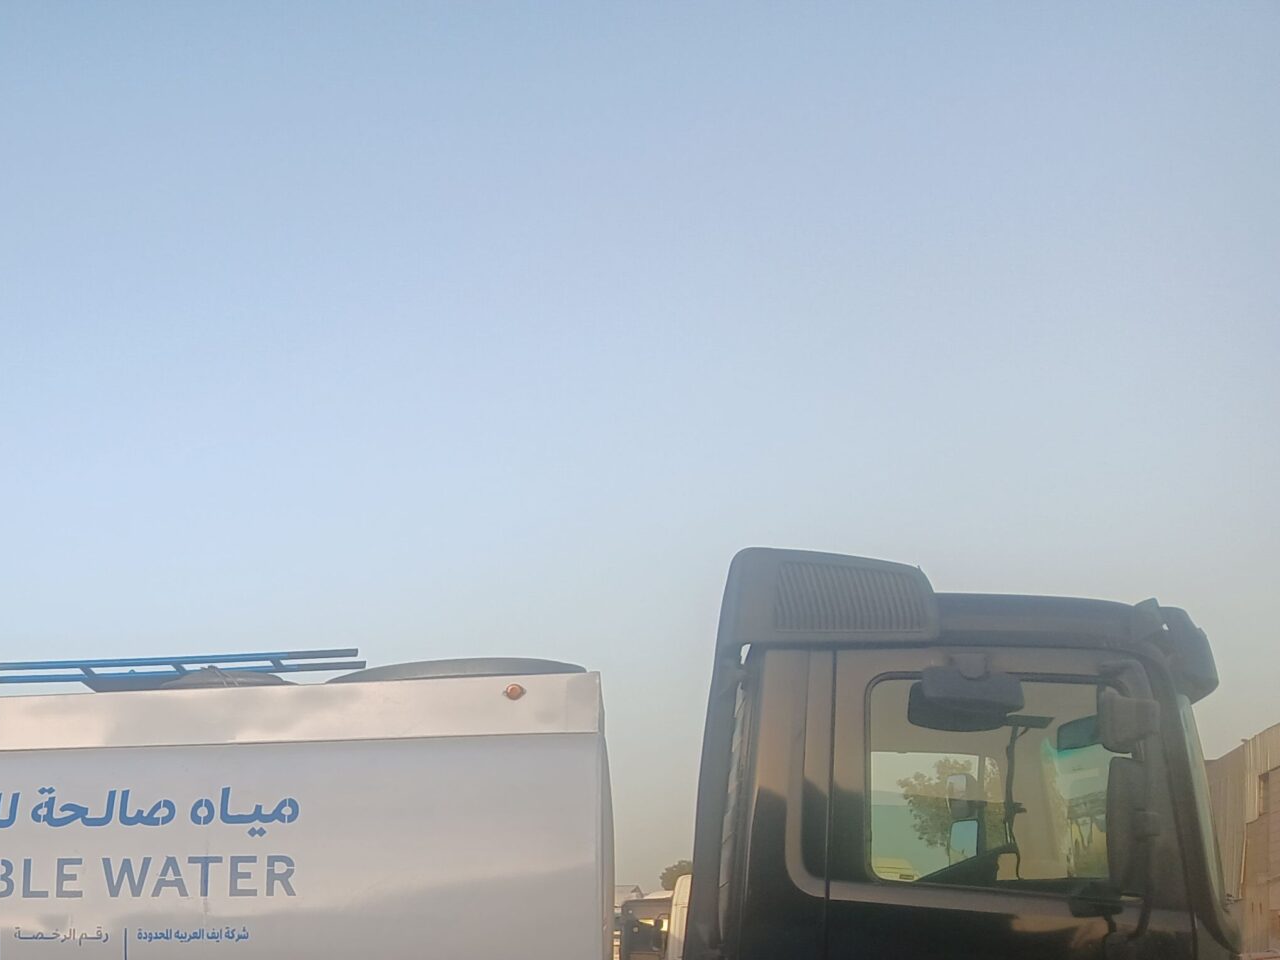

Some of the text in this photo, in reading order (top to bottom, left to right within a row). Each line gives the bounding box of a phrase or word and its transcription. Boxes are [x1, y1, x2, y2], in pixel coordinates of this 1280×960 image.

[31, 786, 177, 828] صالحة
[190, 785, 300, 838] مياه
[101, 854, 298, 899] WATER
[13, 926, 109, 946] رقم الرخصة
[223, 926, 249, 943] شركة
